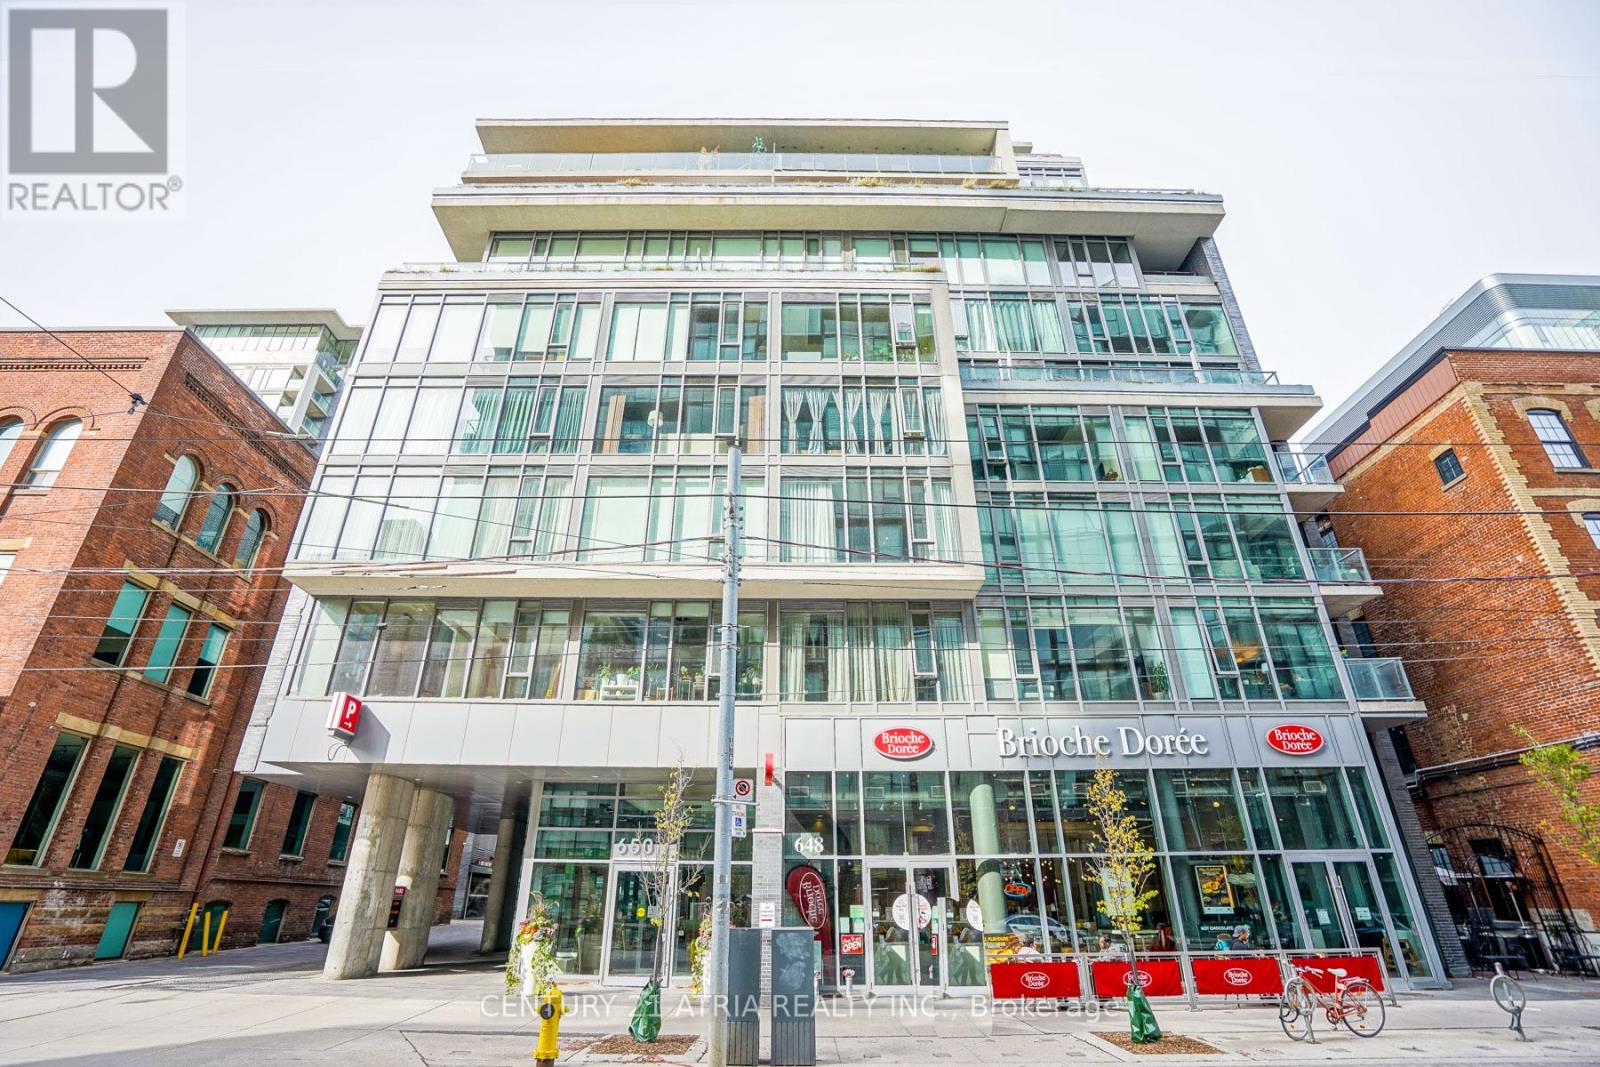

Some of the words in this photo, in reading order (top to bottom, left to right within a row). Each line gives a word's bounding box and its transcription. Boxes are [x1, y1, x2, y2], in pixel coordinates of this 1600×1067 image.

[345, 700, 357, 719] P
[882, 731, 925, 744] Brioche
[996, 725, 1111, 757] Brioche
[1117, 726, 1209, 756] Dorée
[1274, 728, 1316, 741] Brioche
[887, 742, 919, 754] Dorée
[1282, 738, 1313, 751] Dorée
[617, 838, 655, 857] 650
[794, 836, 824, 853] 648
[1004, 883, 1029, 895] OPEN
[841, 939, 863, 953] OPEN
